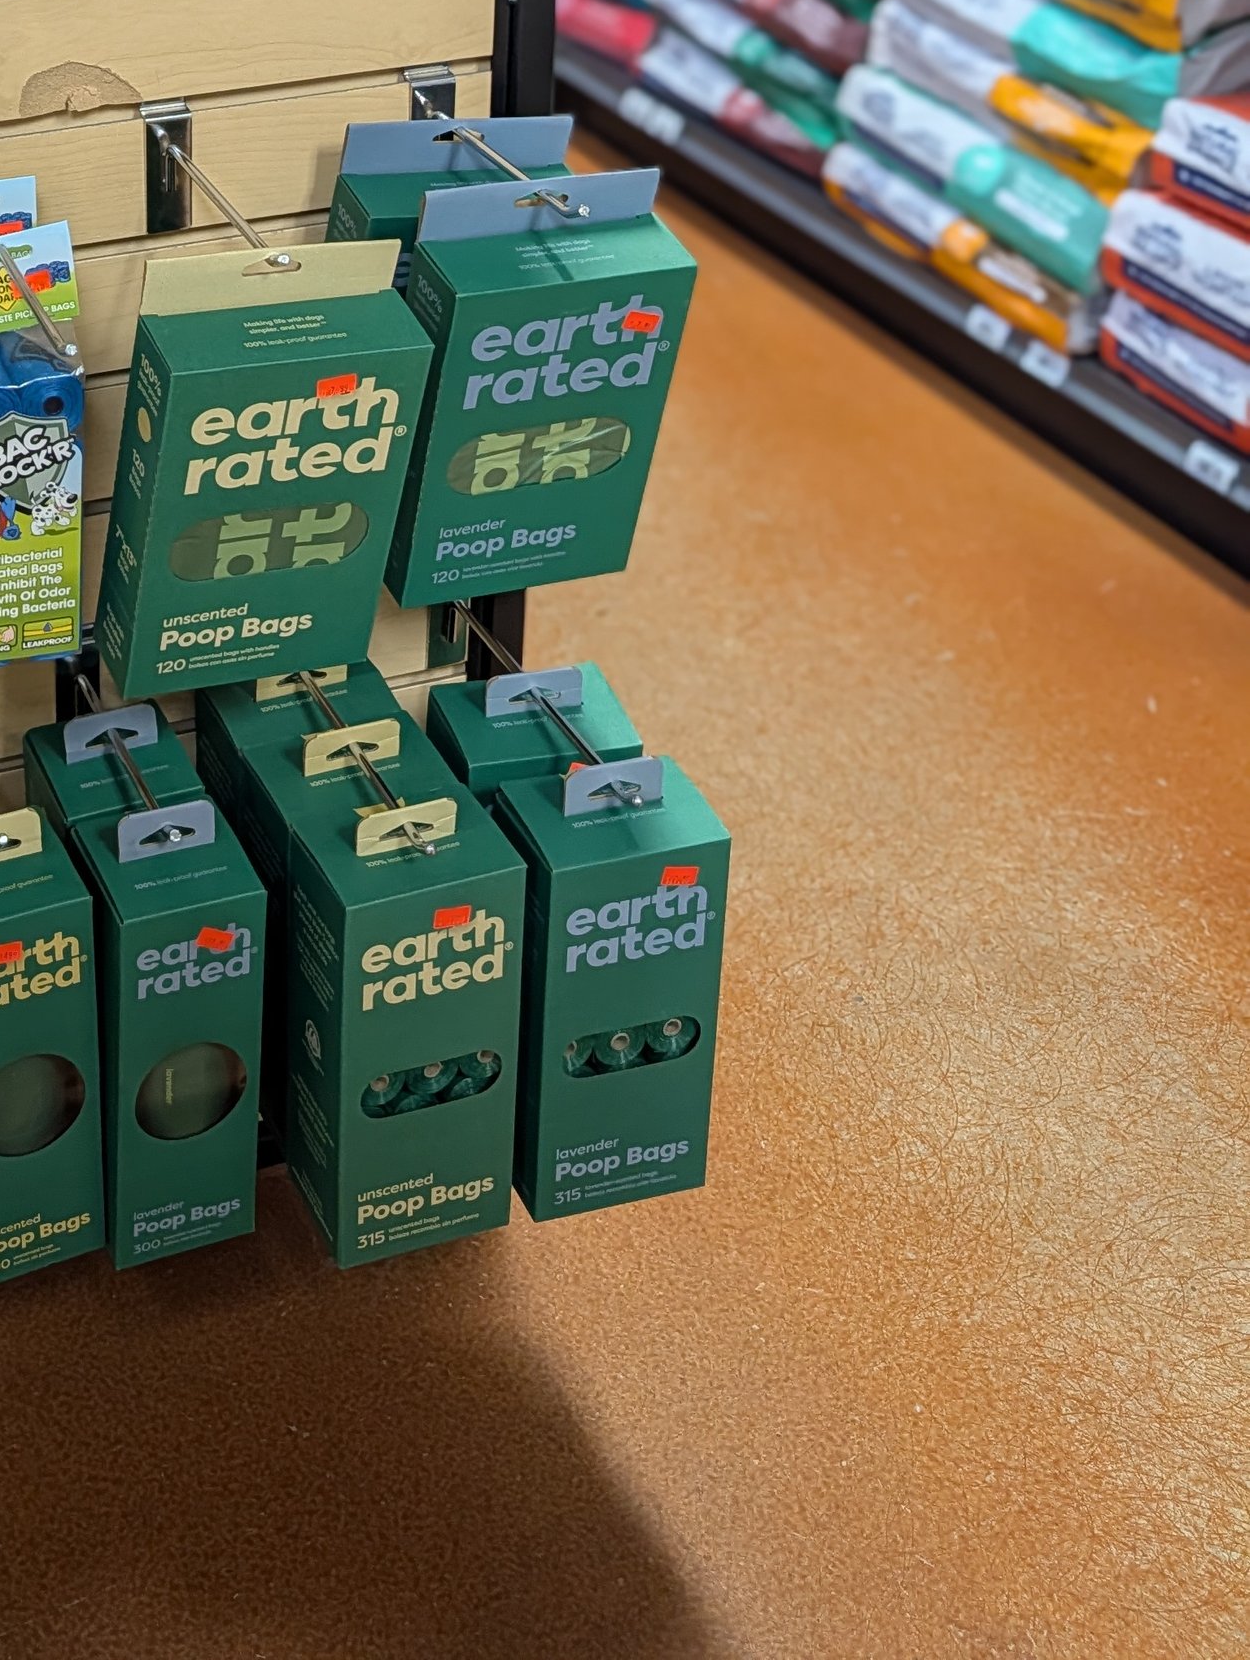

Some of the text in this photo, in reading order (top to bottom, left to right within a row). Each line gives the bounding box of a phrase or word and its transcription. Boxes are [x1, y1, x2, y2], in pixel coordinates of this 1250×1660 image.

[52, 302, 75, 313] BAGS
[462, 342, 659, 411] rated
[183, 427, 394, 496] rated
[31, 562, 63, 575] Bags
[40, 574, 62, 586] The
[20, 589, 36, 601] Of
[39, 585, 71, 598] Odor
[22, 598, 76, 614] Bacteria
[163, 602, 248, 629] unscented
[160, 611, 314, 652] Poop Bags
[156, 658, 187, 675] 120
[362, 944, 504, 1012] rated
[357, 1173, 434, 1202] unscented
[357, 1175, 494, 1225] Poop Bags
[357, 1230, 385, 1249] 315
